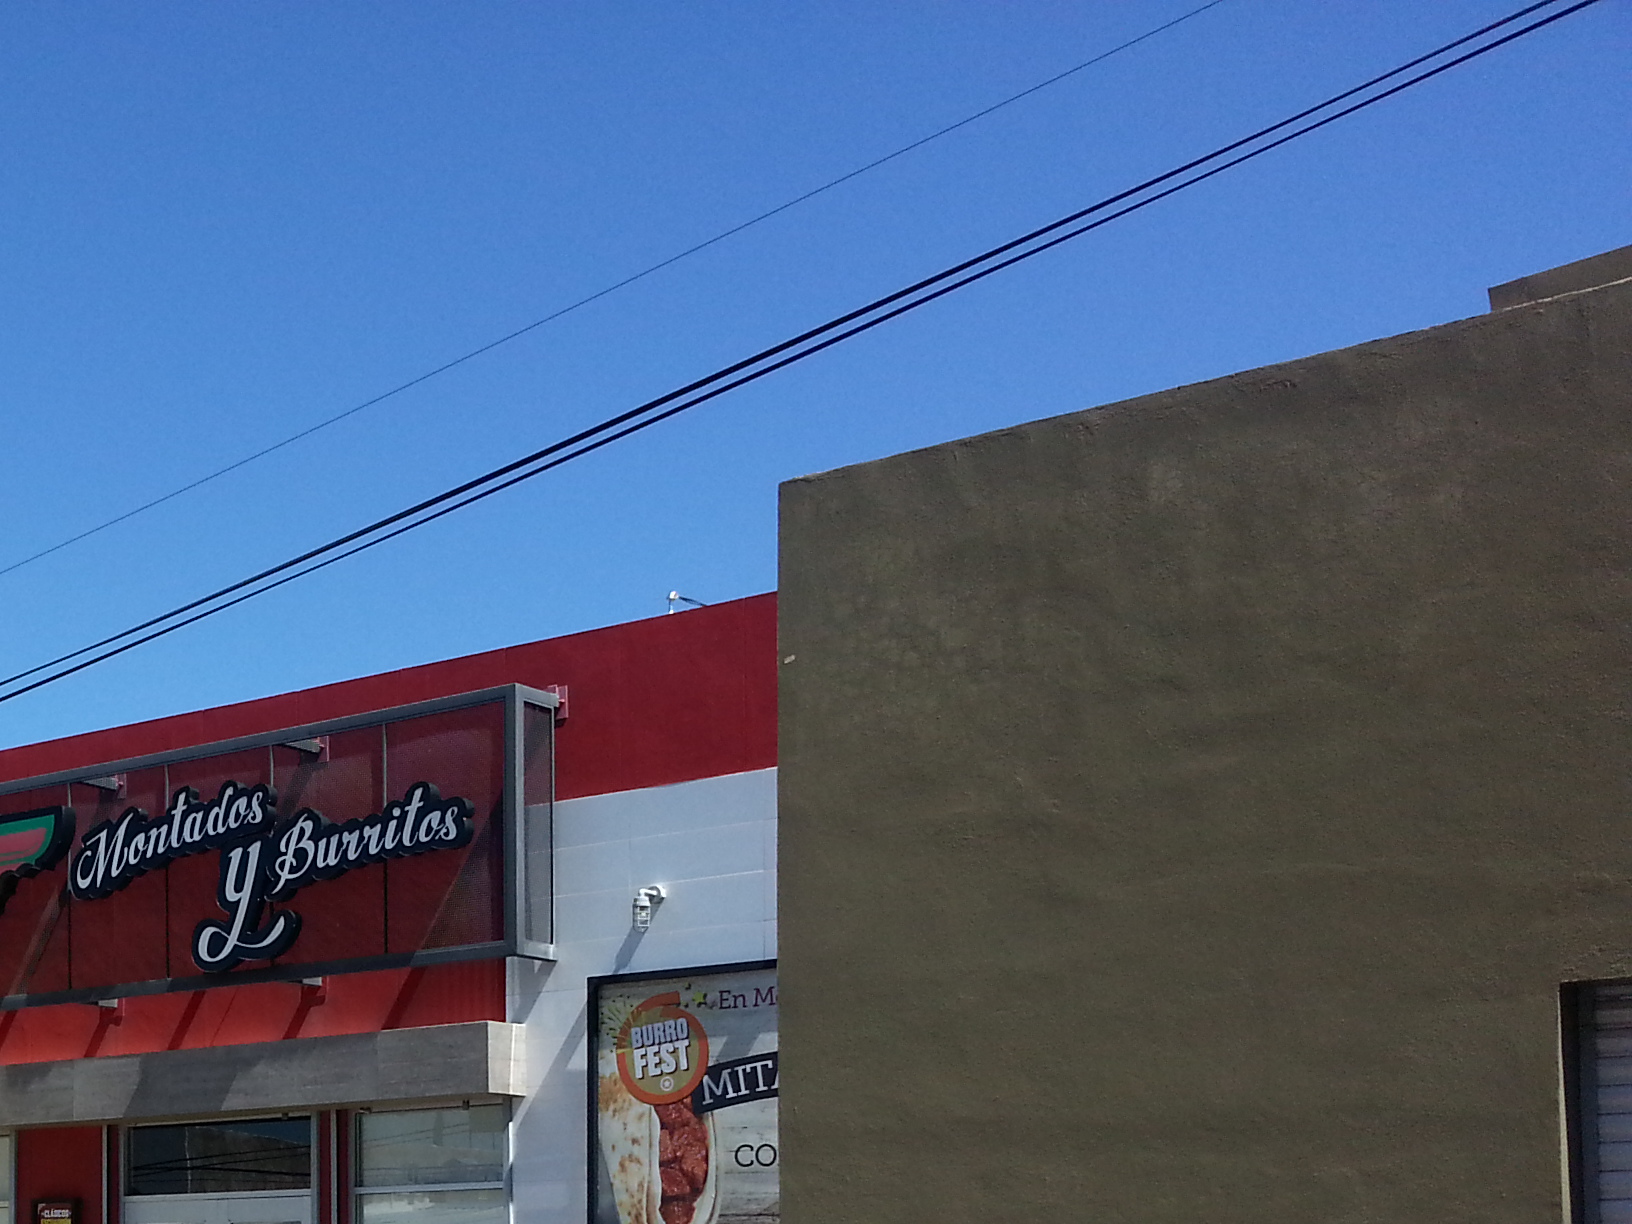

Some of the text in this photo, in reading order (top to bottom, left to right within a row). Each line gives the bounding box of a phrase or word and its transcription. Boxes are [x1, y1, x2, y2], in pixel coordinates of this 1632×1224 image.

[76, 786, 264, 890] Montados
[272, 786, 459, 894] Burritos
[718, 986, 778, 1010] En M
[631, 1017, 688, 1049] BURRO
[633, 1039, 690, 1079] FEST
